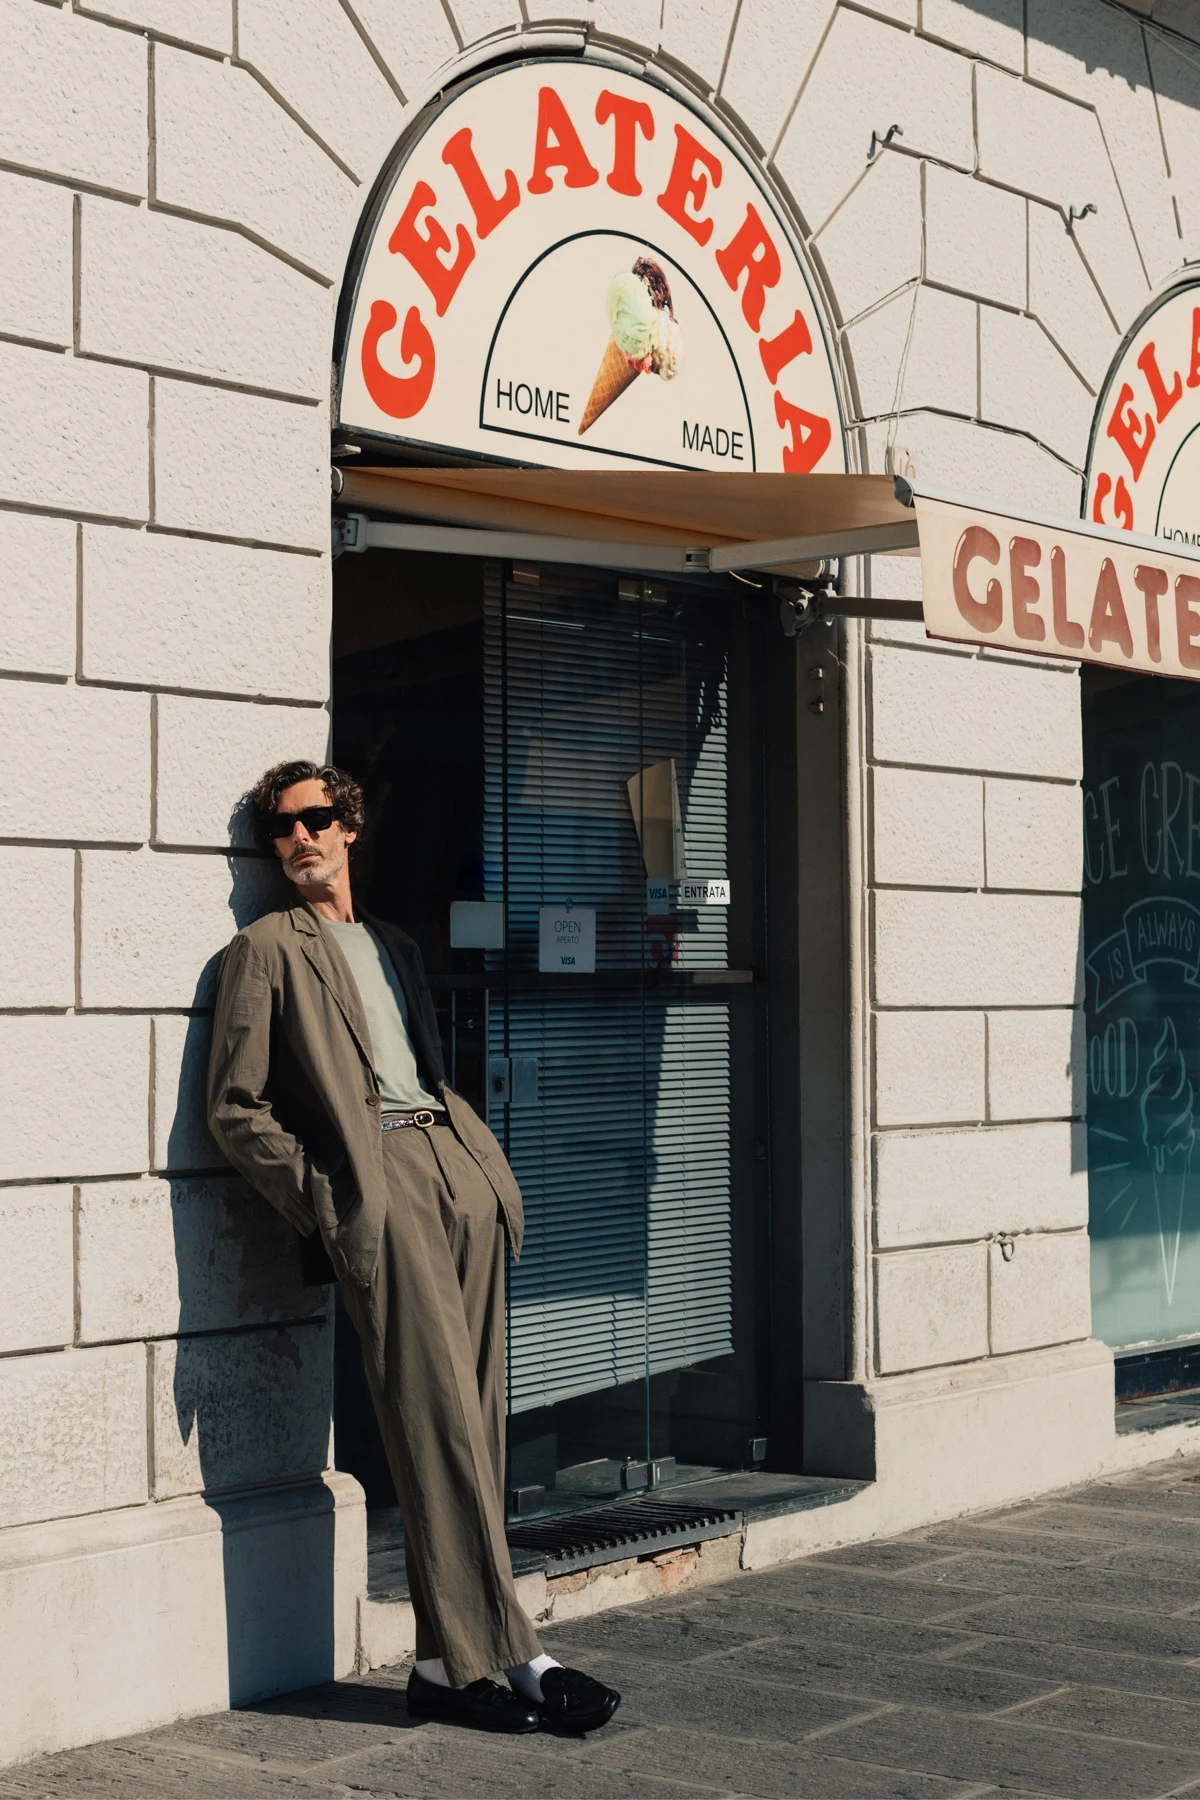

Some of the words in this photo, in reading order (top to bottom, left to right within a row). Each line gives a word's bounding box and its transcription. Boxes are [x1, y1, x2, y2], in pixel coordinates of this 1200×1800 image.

[361, 86, 832, 474] GELATERIA
[496, 378, 570, 424] HOME
[682, 419, 744, 461] MADE
[952, 525, 1200, 671] GELATE
[648, 888, 668, 899] VISA
[684, 886, 726, 898] ENTRATA
[554, 920, 581, 933] OPEN
[556, 935, 580, 944] APERTO
[1107, 947, 1124, 984] IS
[1137, 910, 1195, 954] ALWAYS
[560, 956, 576, 965] VISA
